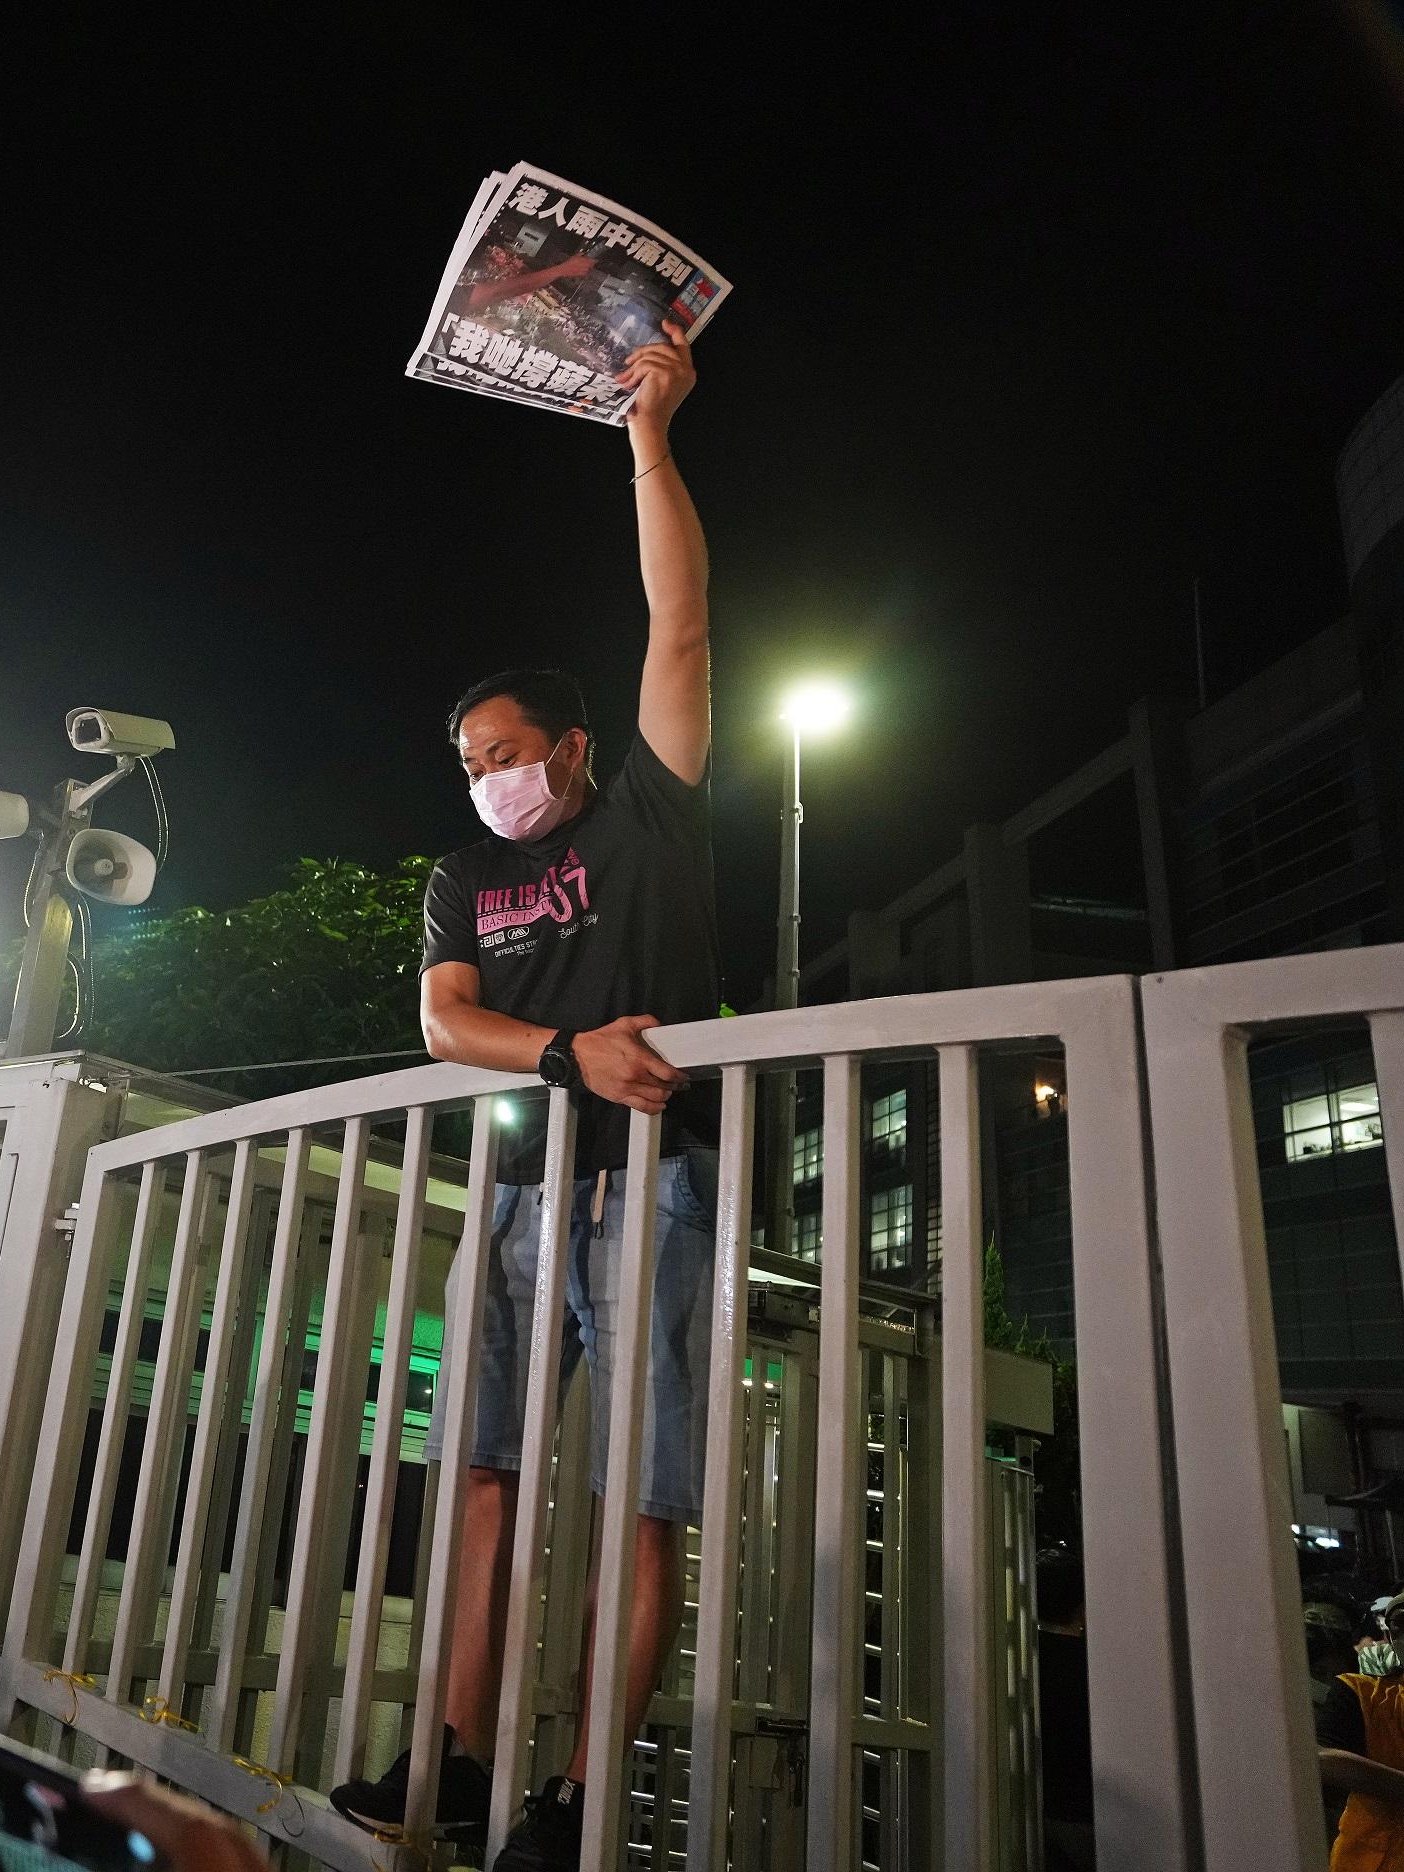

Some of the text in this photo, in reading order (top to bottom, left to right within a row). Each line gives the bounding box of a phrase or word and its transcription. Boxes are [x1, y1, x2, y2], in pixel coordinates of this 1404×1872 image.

[508, 182, 694, 287] 港人雨中痛別
[477, 888, 513, 914] FREE
[518, 884, 536, 907] IS
[481, 911, 519, 931] BASIC
